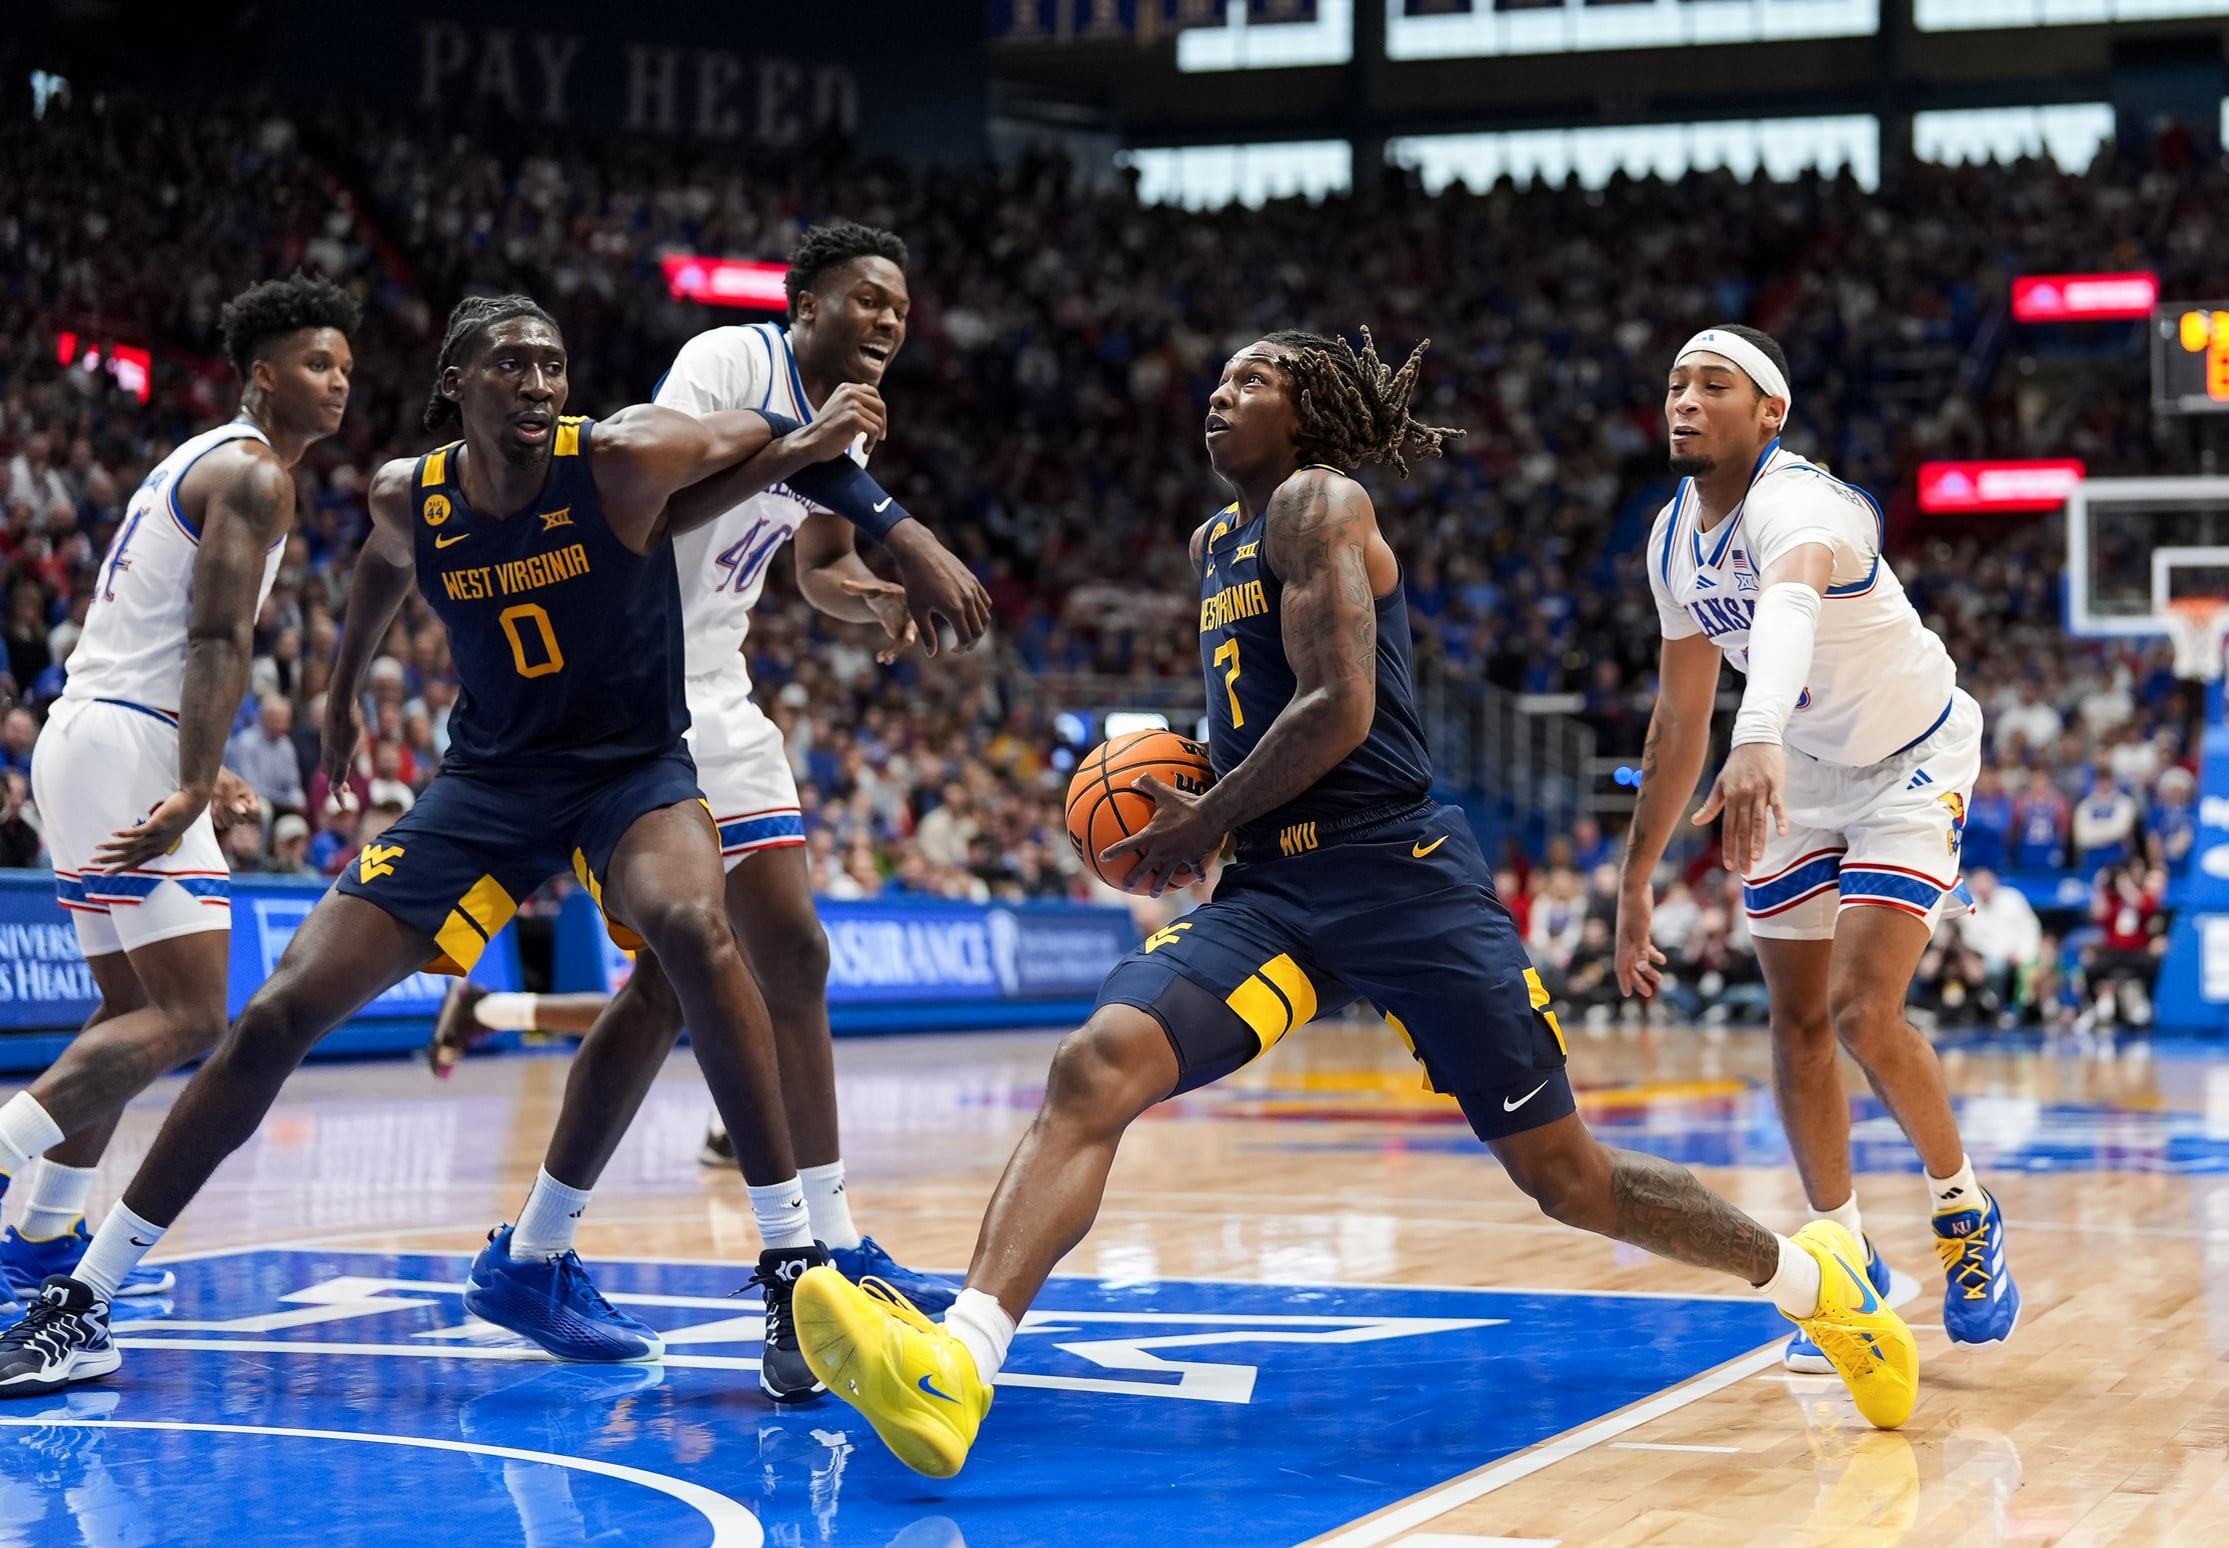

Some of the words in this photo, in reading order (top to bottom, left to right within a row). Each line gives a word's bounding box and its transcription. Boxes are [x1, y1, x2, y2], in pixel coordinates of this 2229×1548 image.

[419, 19, 583, 124] PAY
[625, 40, 858, 147] HEED
[426, 506, 444, 519] 44
[441, 566, 494, 601] WEST
[494, 543, 592, 596] VIRGINIA
[715, 517, 793, 593] 40
[499, 603, 566, 680] 0
[1213, 638, 1245, 729] 7
[1280, 821, 1319, 857] WVU
[1952, 1220, 1971, 1235] KU
